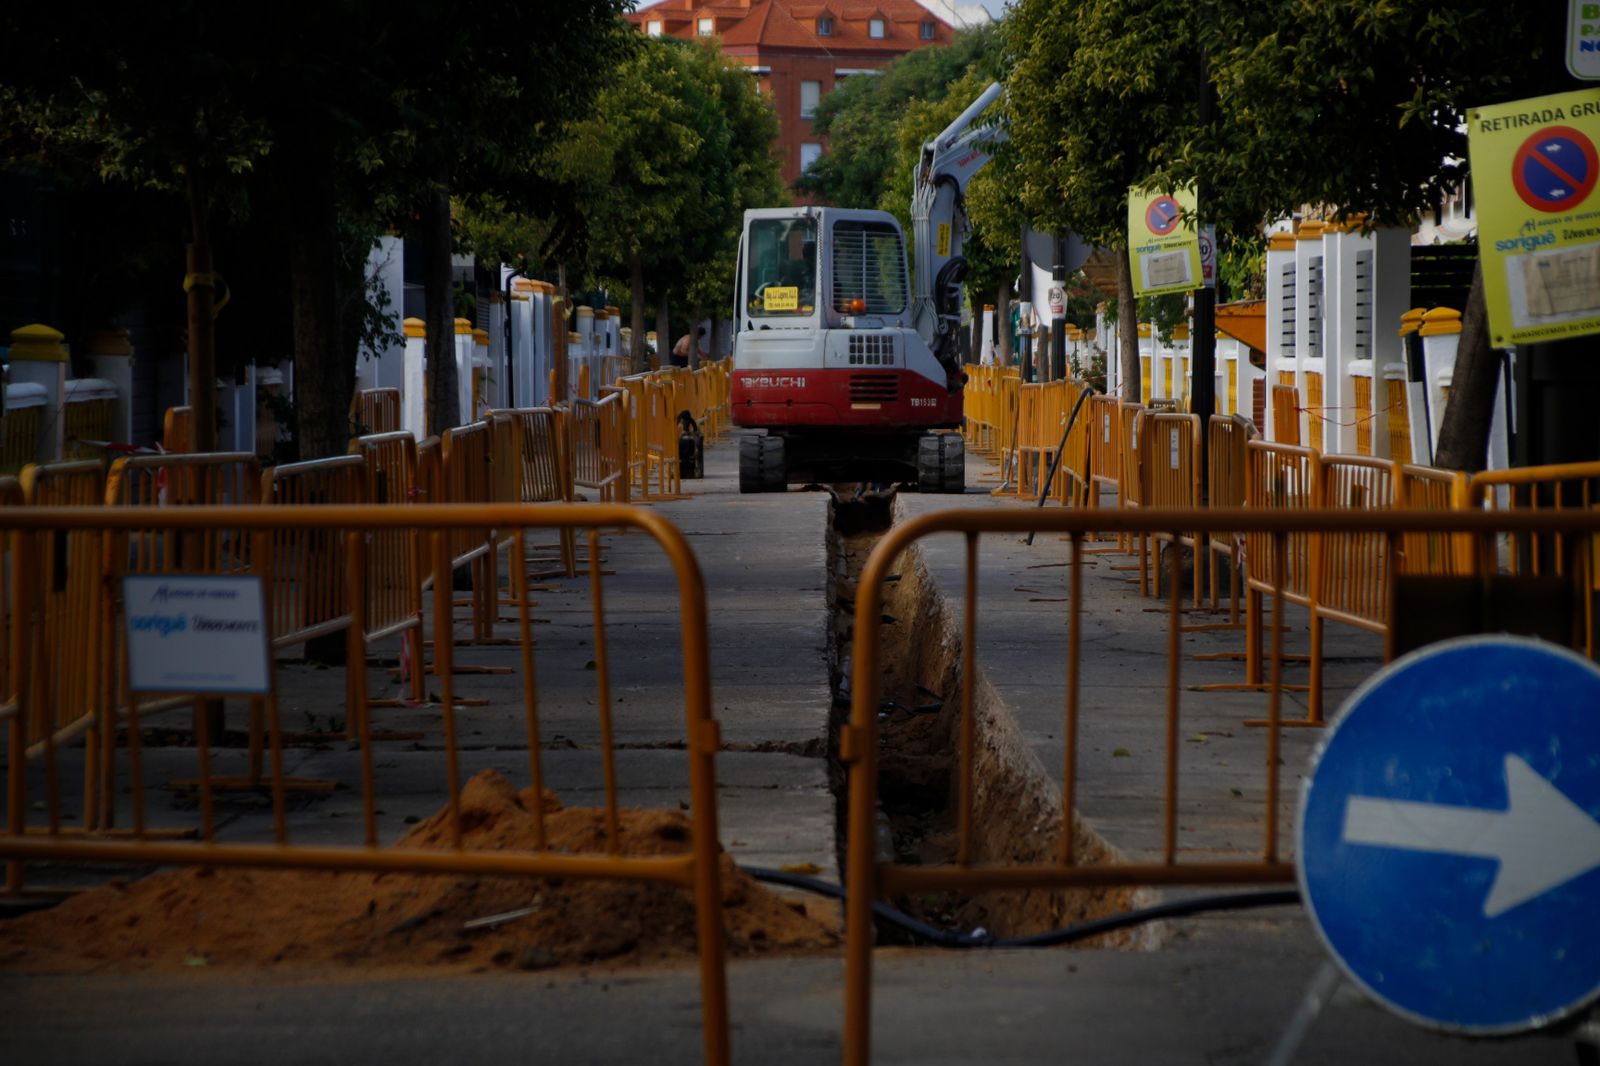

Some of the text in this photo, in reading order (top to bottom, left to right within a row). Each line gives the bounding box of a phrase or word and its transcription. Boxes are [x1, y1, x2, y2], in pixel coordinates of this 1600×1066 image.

[1480, 107, 1566, 133] RETIRADA
[1495, 230, 1557, 252] sorigué
[740, 377, 807, 388] TAKEUCHI
